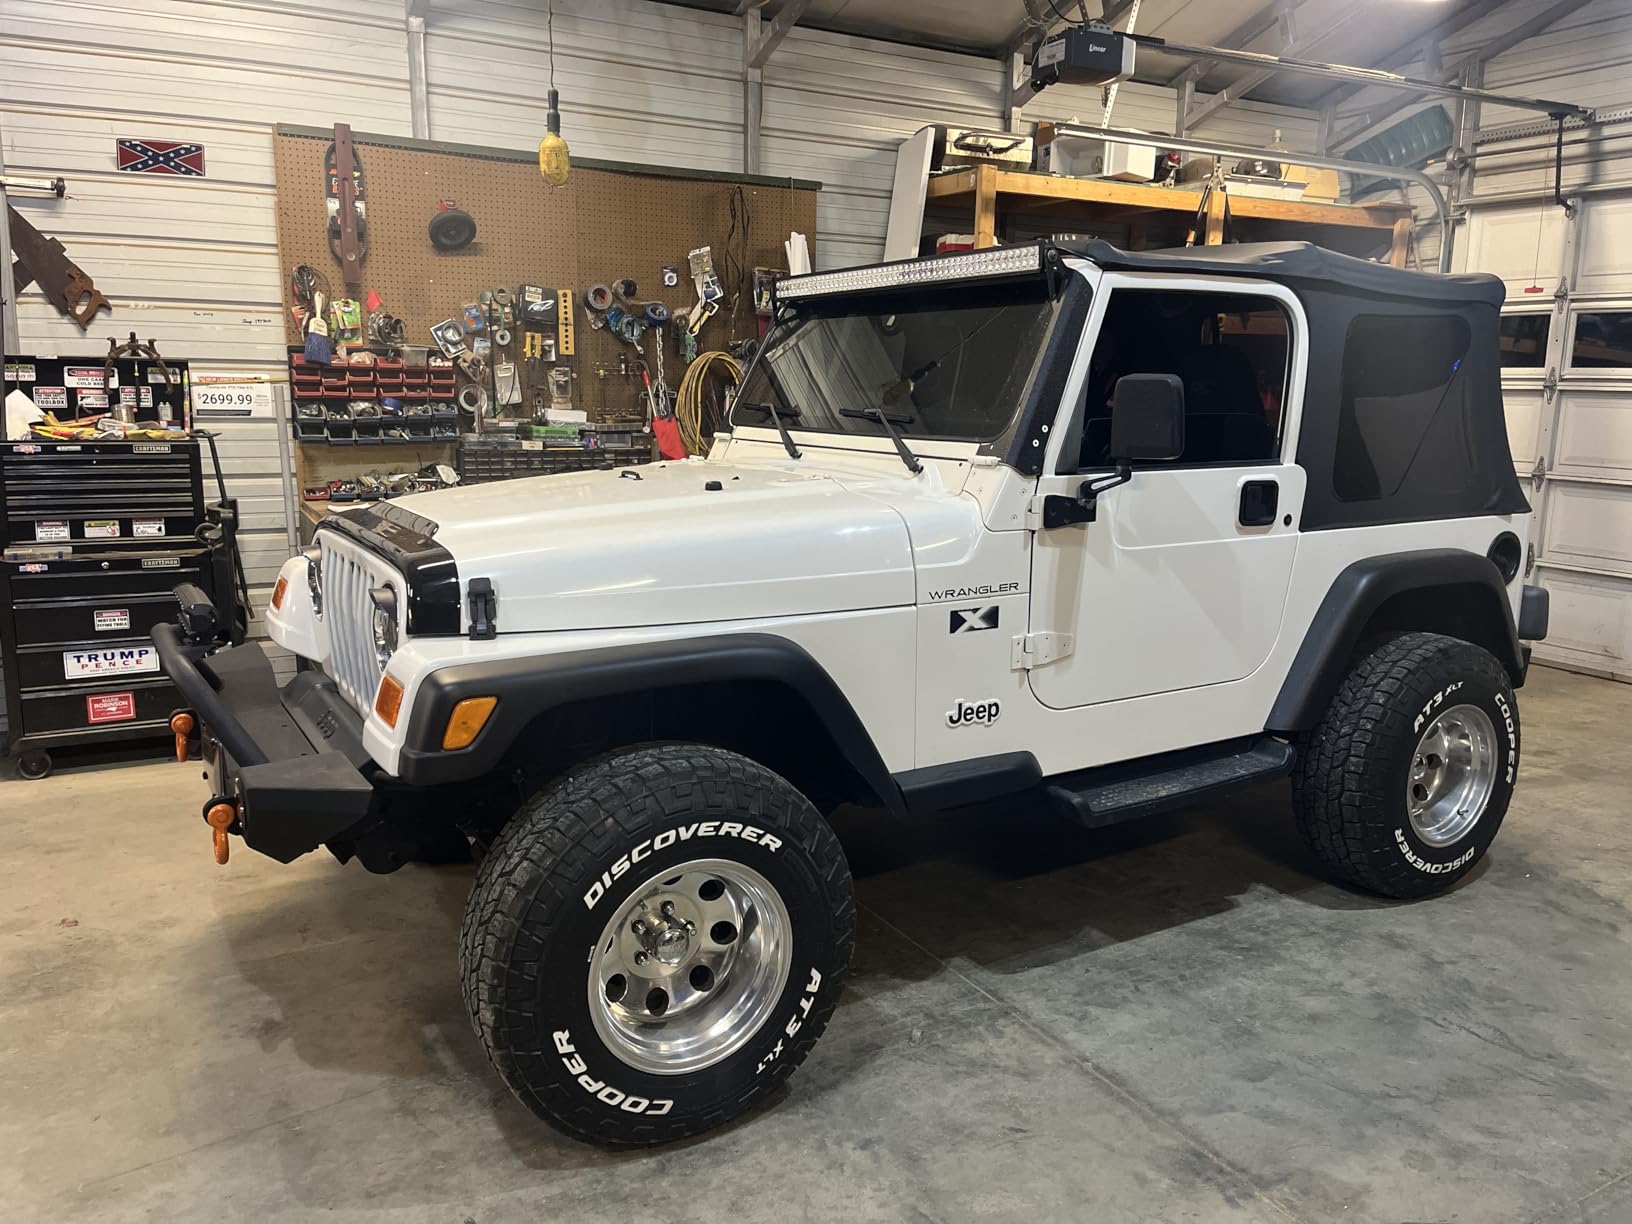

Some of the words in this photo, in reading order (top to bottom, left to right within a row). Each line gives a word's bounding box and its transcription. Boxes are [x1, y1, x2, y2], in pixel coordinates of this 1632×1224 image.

[1089, 44, 1106, 52] Linear
[929, 582, 1019, 600] WRANGLER
[73, 649, 149, 664] TRUMP
[81, 659, 143, 669] PENCE
[94, 700, 128, 709] ROBINSON
[948, 702, 1000, 725] Jeep
[1414, 691, 1444, 734] AT3
[1444, 681, 1464, 696] XLT
[1494, 692, 1516, 784] COOPER
[583, 821, 783, 911] DISCOVERER
[1394, 828, 1475, 874] DISCOVERER
[785, 967, 823, 1040] AT3
[552, 1028, 674, 1115] COOPER
[755, 1037, 785, 1074] XLT
